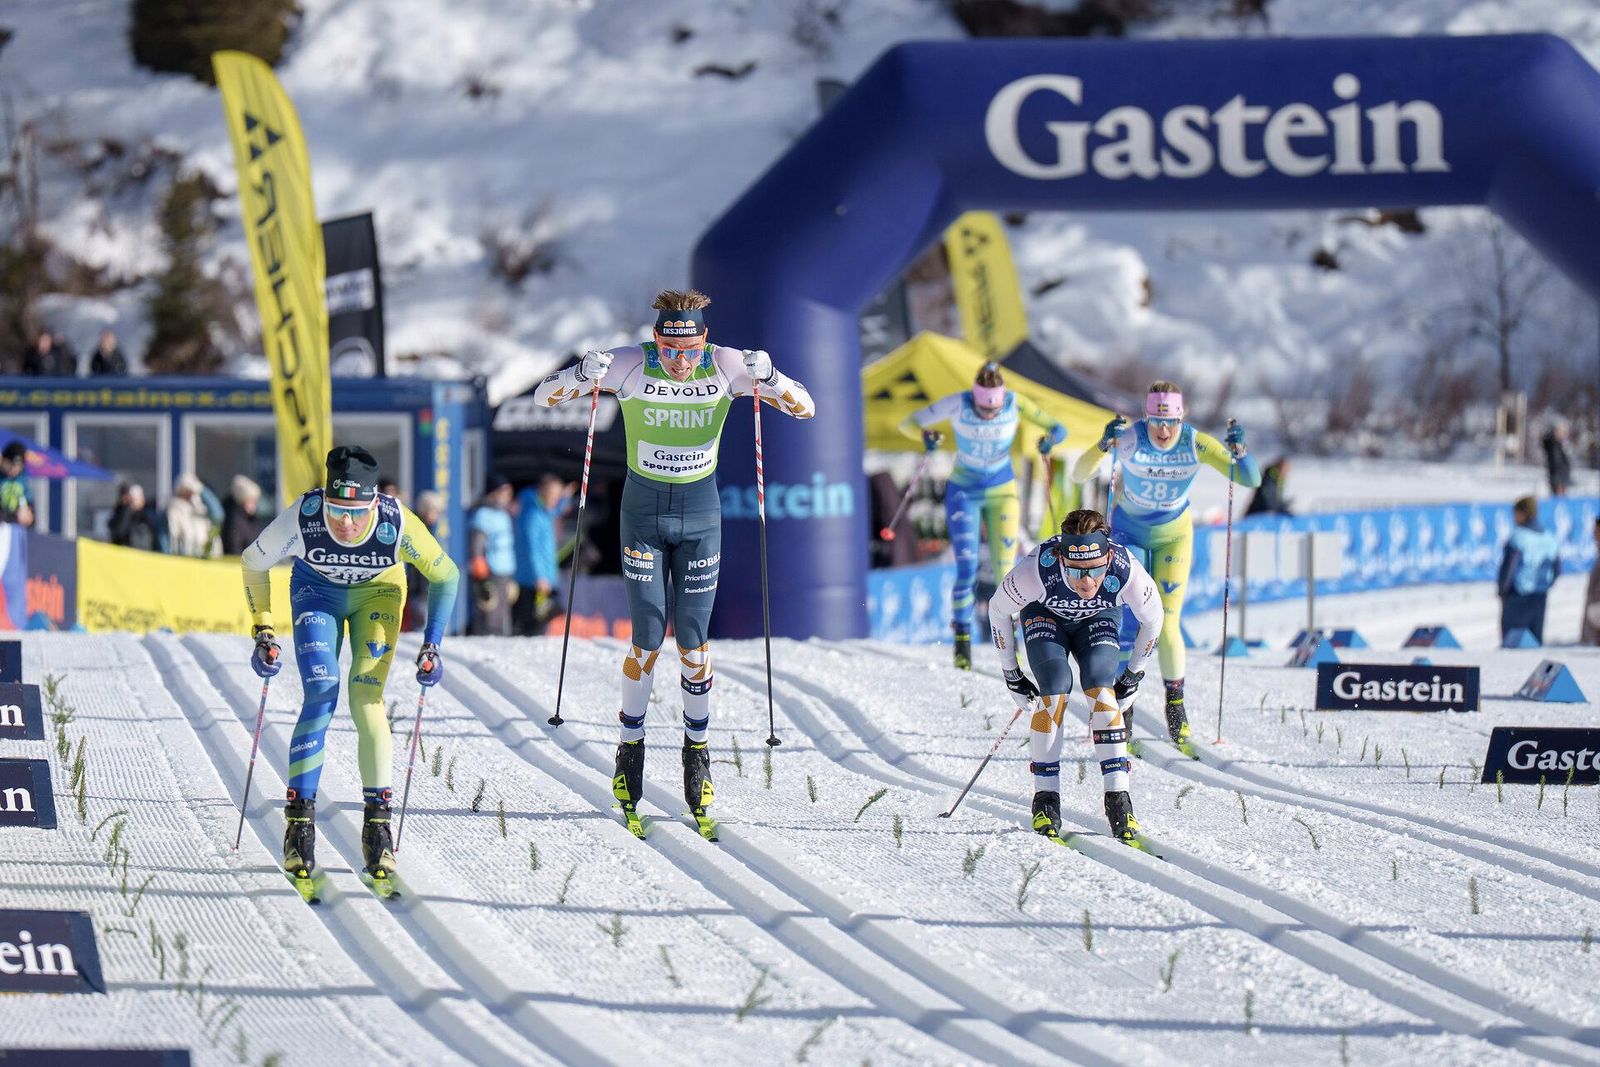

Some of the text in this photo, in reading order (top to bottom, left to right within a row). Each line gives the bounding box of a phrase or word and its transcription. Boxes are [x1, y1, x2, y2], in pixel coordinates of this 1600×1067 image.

[984, 73, 1450, 180] Gastein
[643, 383, 719, 396] DEVOLD
[643, 407, 717, 428] SPRINT
[653, 450, 704, 462] Gastein
[642, 459, 712, 473] Sportgastein
[720, 471, 855, 519] astein
[1141, 481, 1167, 500] 28
[302, 526, 328, 534] GASTEIN
[307, 547, 393, 566] Gastein
[1045, 595, 1113, 609] Gastein
[304, 616, 326, 625] polo
[1332, 671, 1464, 703] Gastein
